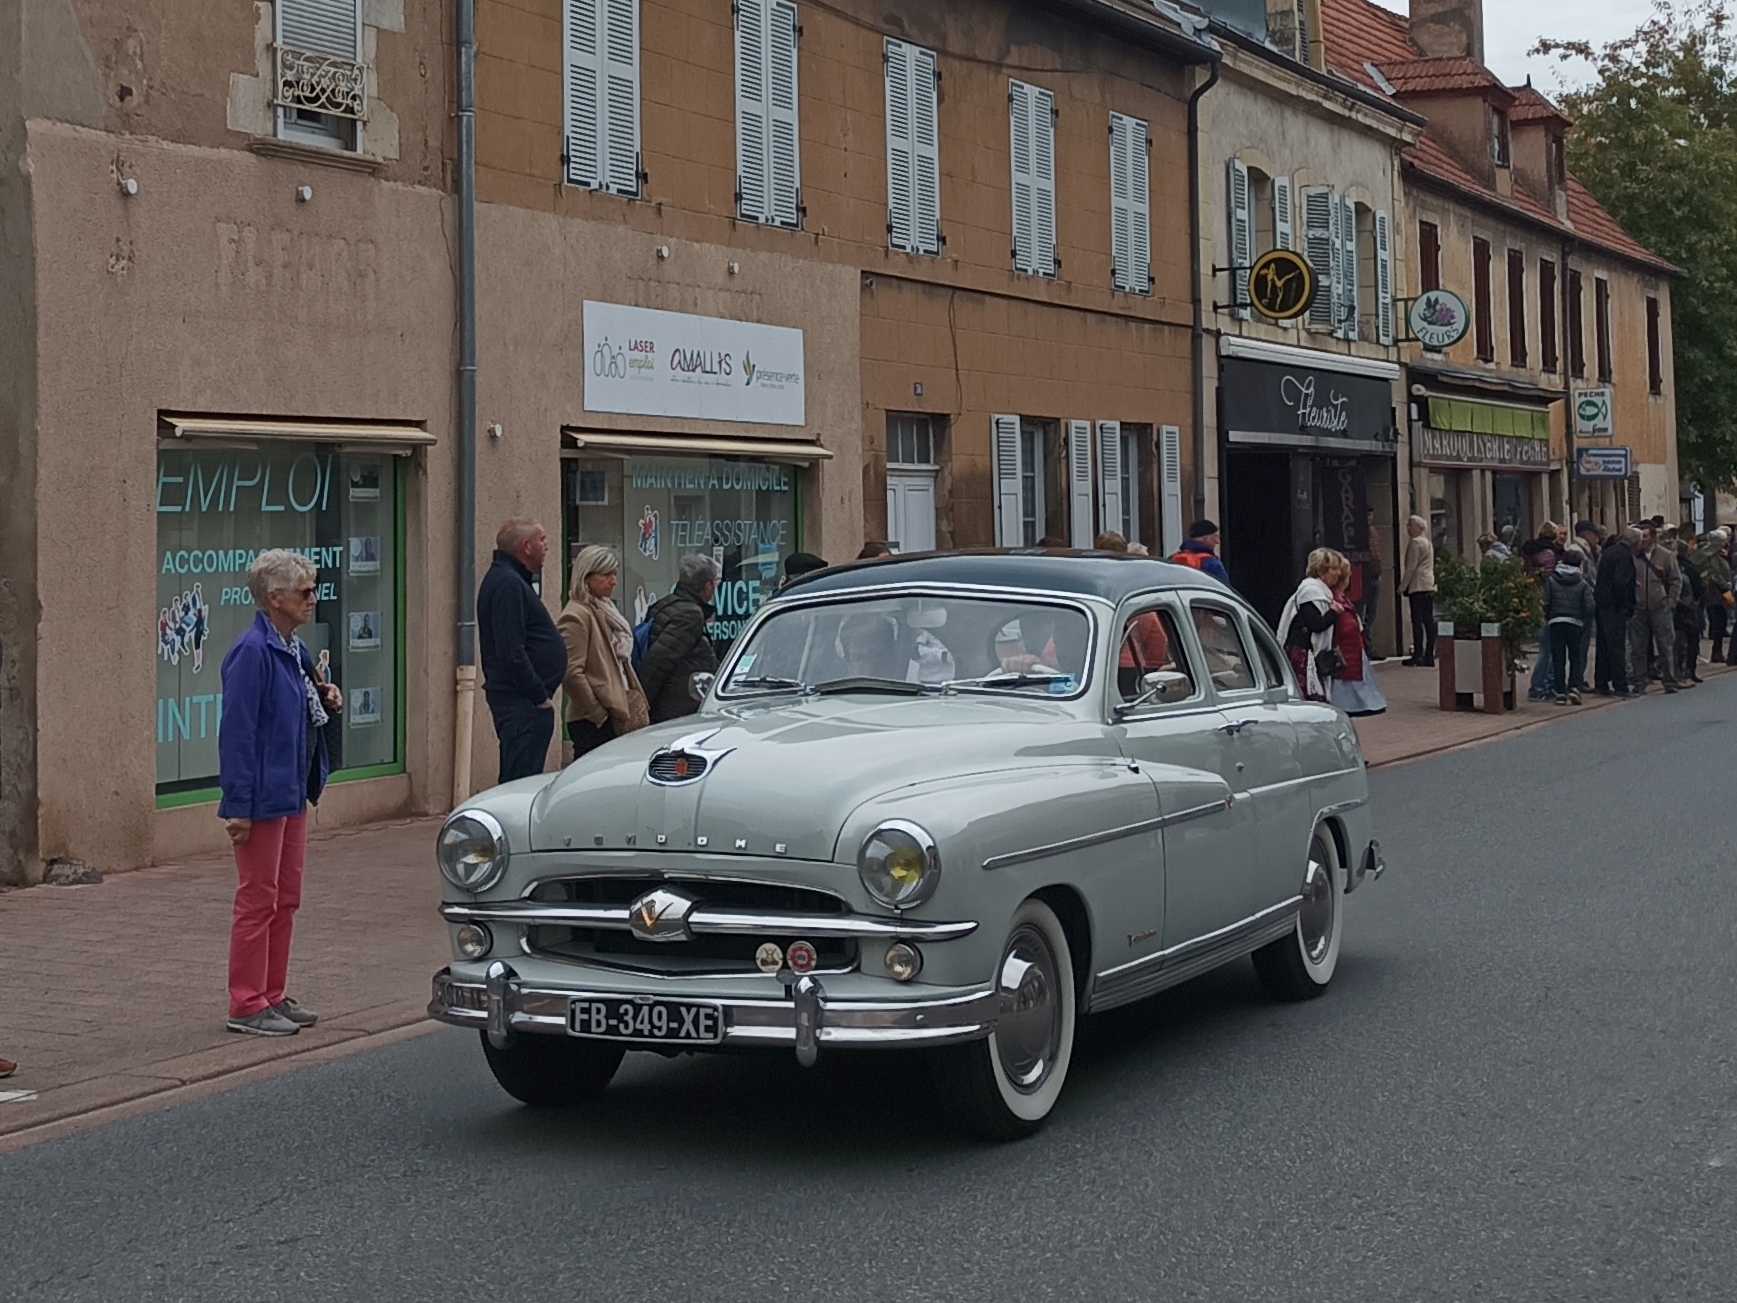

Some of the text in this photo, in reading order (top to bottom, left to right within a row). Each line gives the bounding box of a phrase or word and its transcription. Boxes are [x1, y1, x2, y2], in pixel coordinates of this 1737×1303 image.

[628, 338, 655, 354] LASER
[1416, 325, 1460, 344] FLEURS
[1281, 375, 1348, 432] Fleuriste
[157, 453, 334, 512] EMPLOI
[632, 463, 705, 489] MAINTIEN
[722, 466, 789, 491] DOMICILE
[670, 516, 788, 547] TÉLÉASSISTANCE
[574, 1001, 715, 1040] FB-349-XE
